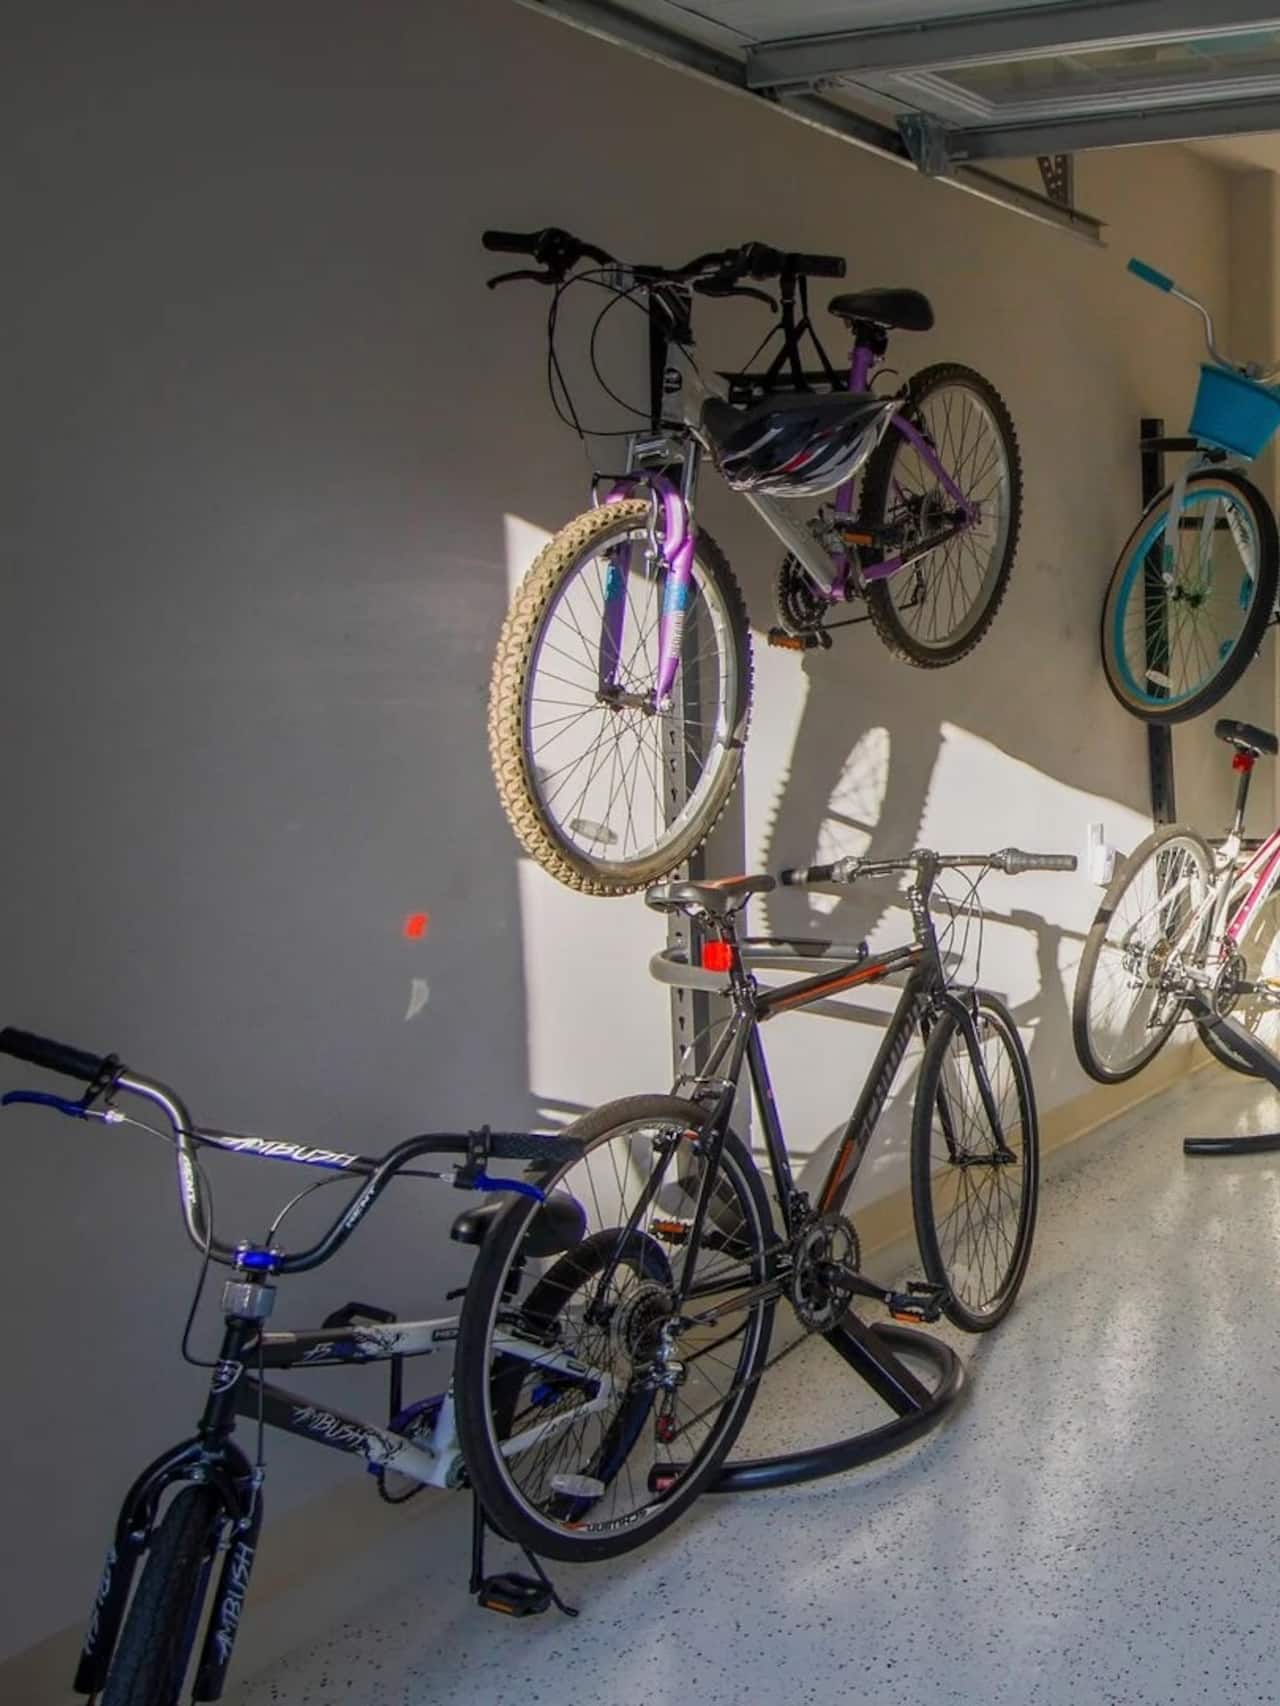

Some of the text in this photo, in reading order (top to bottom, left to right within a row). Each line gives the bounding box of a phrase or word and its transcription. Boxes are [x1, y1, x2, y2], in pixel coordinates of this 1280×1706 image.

[221, 1136, 359, 1167] AMBUSH
[292, 1405, 367, 1449] AMBUSH
[216, 1541, 255, 1665] AMBUSH
